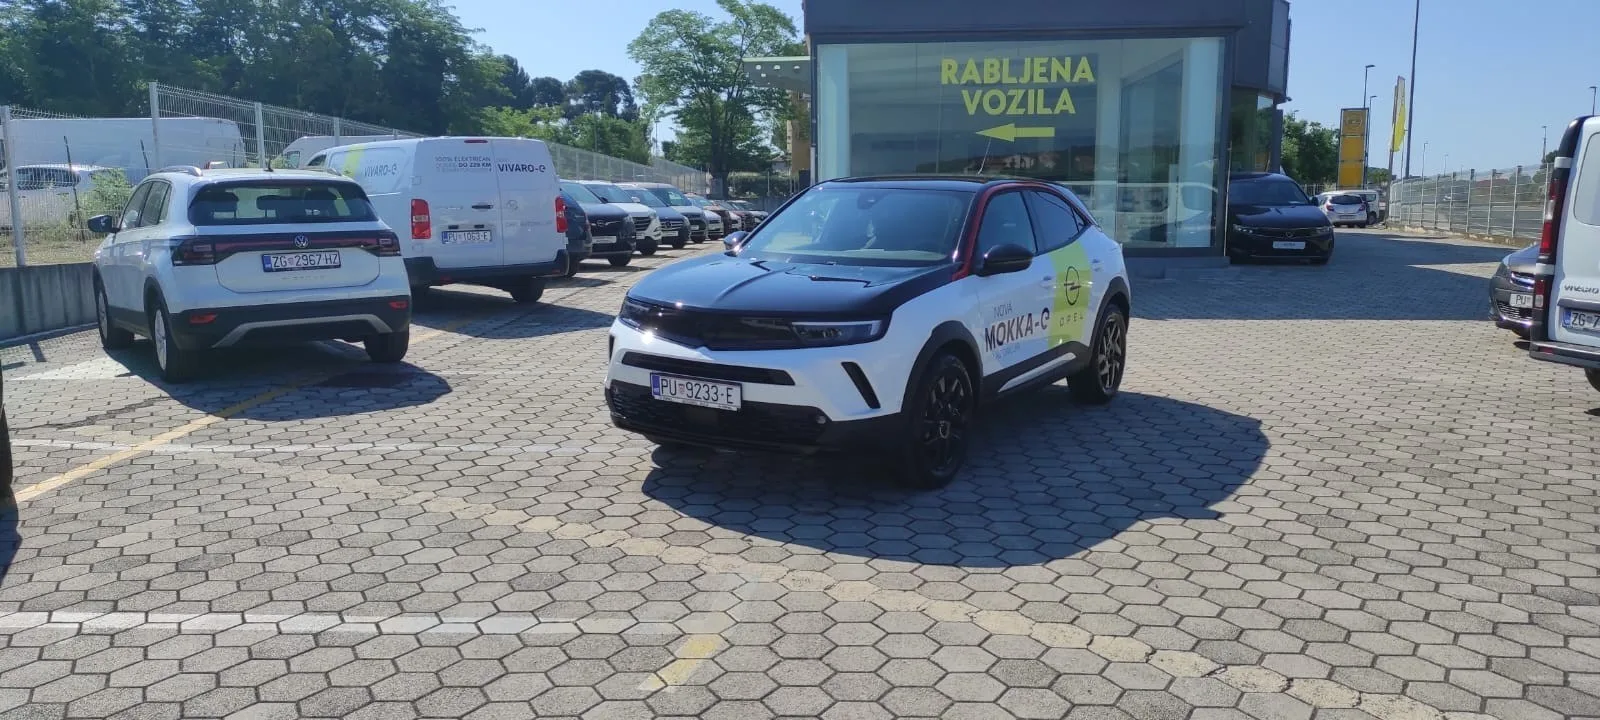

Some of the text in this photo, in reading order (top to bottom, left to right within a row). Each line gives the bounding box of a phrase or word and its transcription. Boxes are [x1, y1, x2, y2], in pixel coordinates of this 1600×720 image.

[940, 56, 1095, 85] RABLJENA
[961, 88, 1076, 116] VOZILA
[272, 256, 288, 268] ZG
[294, 253, 322, 267] 2967
[1516, 294, 1527, 305] PU
[1571, 312, 1586, 327] ZG
[661, 378, 678, 396] PU
[685, 382, 735, 404] 9233-E
